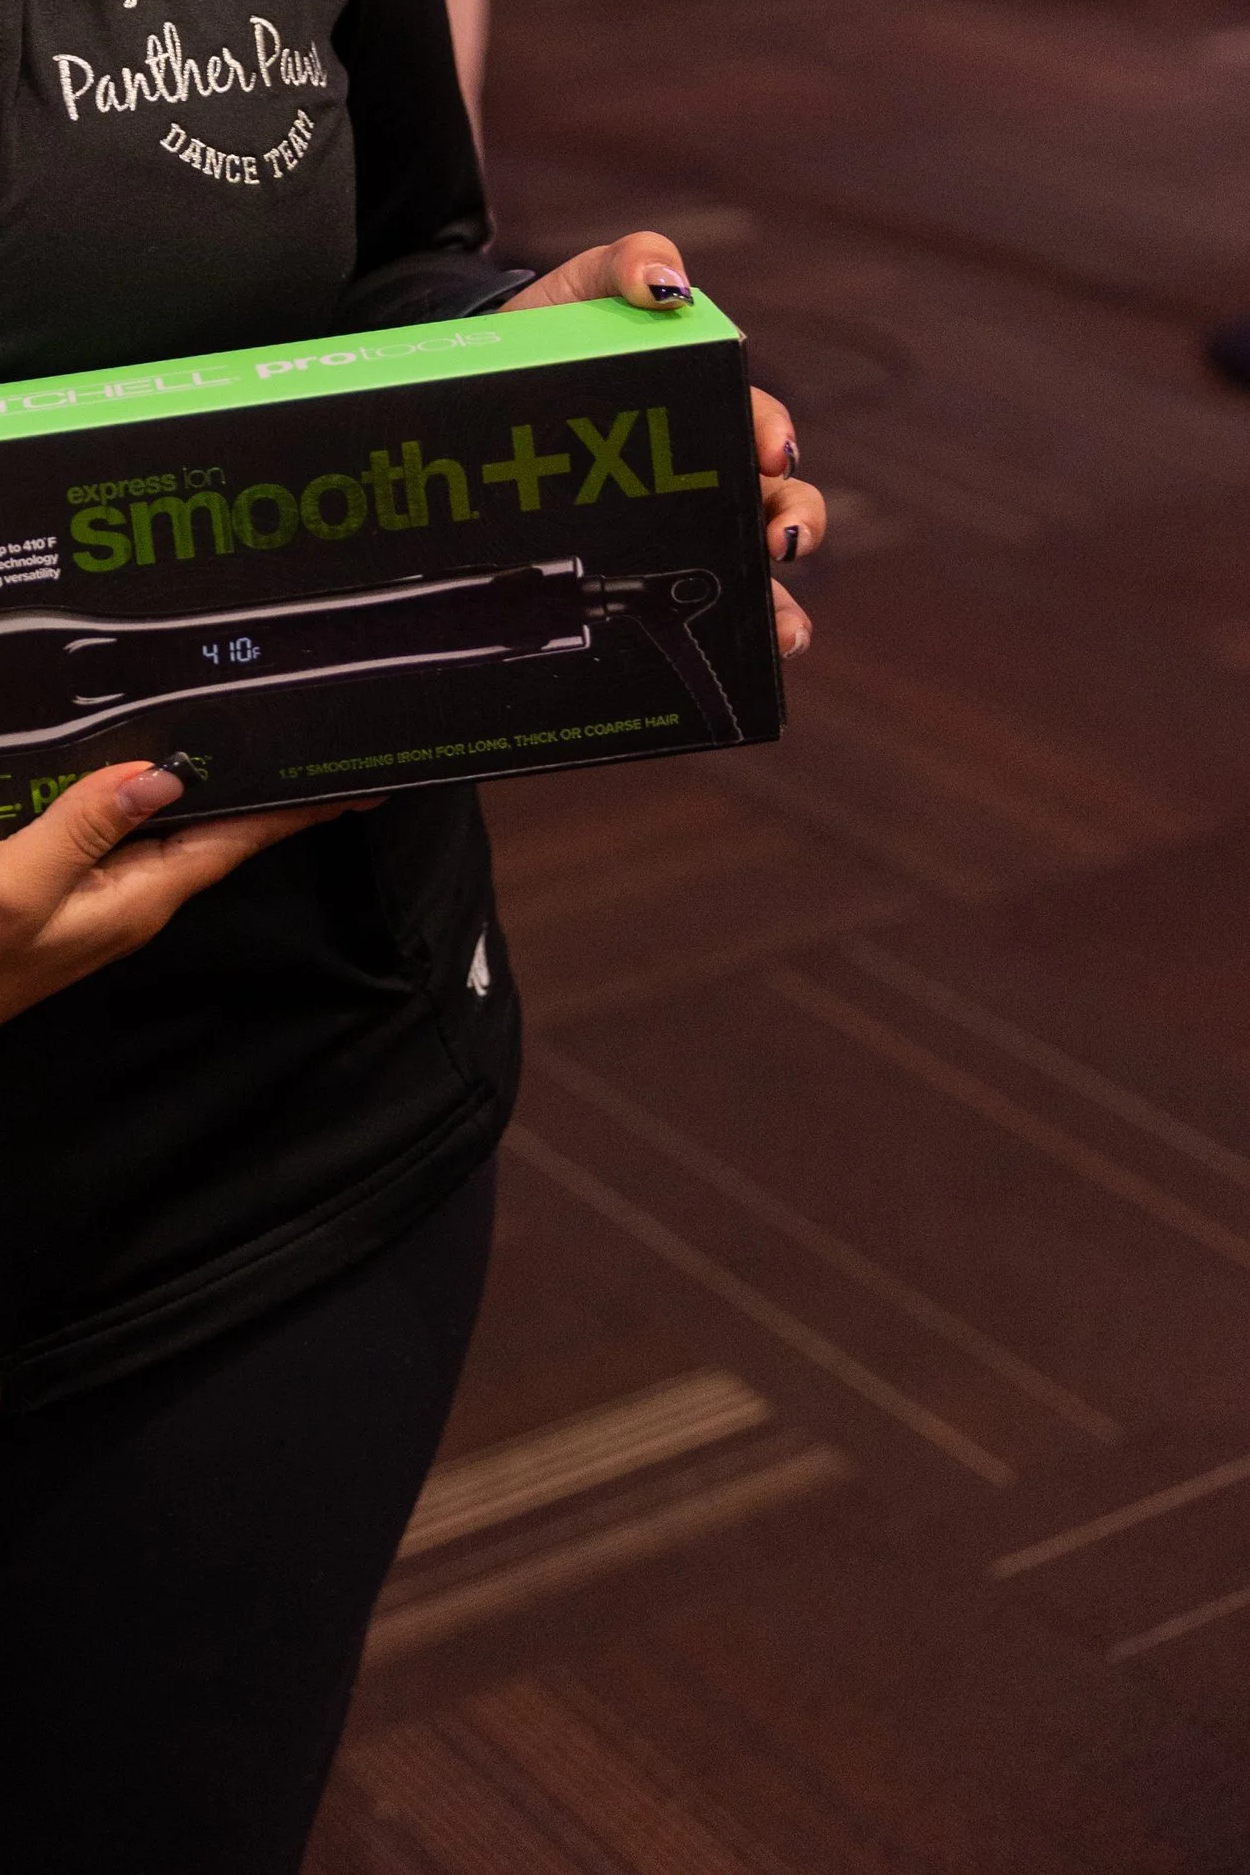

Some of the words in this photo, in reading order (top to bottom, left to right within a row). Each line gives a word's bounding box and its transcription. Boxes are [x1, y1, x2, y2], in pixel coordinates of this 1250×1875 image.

[52, 21, 256, 121] Panther
[160, 123, 260, 185] DANCE
[263, 109, 315, 179] TEAM
[255, 331, 501, 380] protools
[66, 472, 177, 507] express
[182, 465, 227, 490] ion
[8, 542, 21, 554] to
[4, 568, 61, 585] versatility
[306, 752, 394, 775] SMOOTHING
[398, 747, 434, 765] IRON
[435, 742, 467, 759] FOR
[514, 730, 558, 748] THICK
[559, 726, 583, 741] OR
[584, 717, 643, 738] COARSE
[645, 713, 680, 729] HAIR
